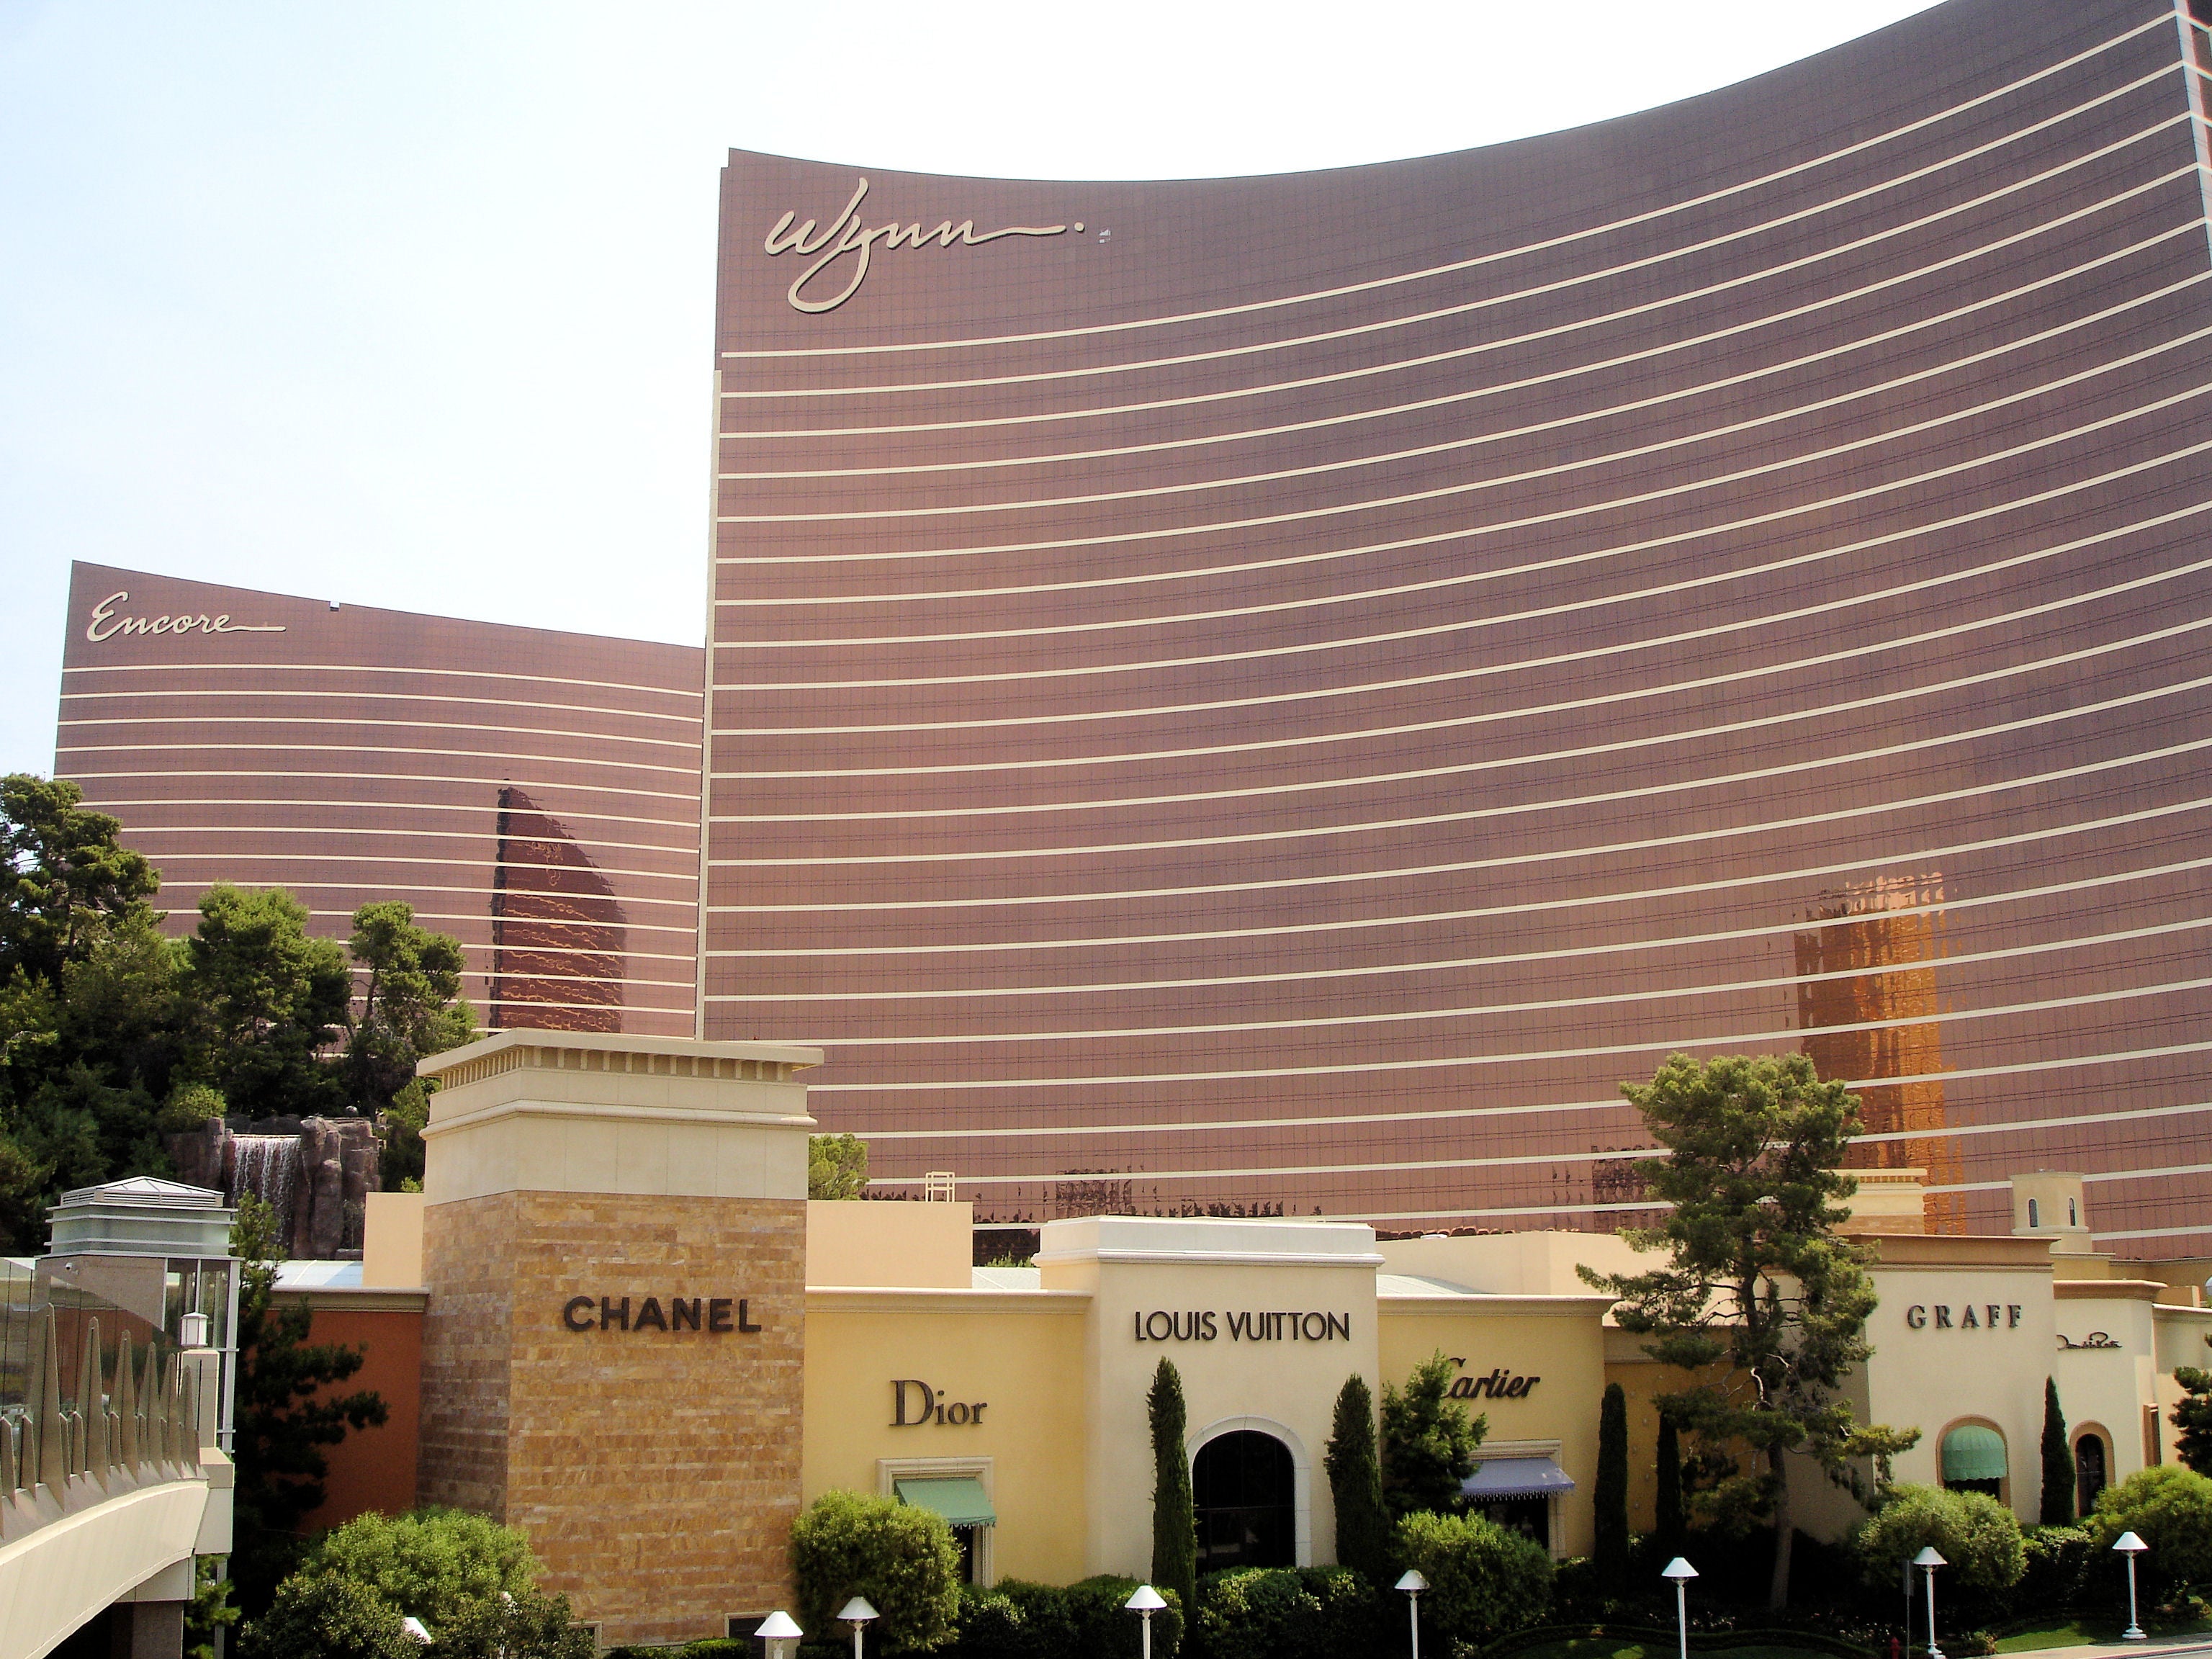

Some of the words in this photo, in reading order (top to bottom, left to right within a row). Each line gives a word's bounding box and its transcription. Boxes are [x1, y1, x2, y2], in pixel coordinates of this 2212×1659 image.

[86, 591, 287, 642] Encore
[564, 1295, 762, 1332] CHANEL
[1135, 1310, 1218, 1341] LOUIS
[1226, 1311, 1349, 1341] VUITTON
[1907, 1304, 2022, 1329] GRAFF
[889, 1380, 988, 1426] Dior
